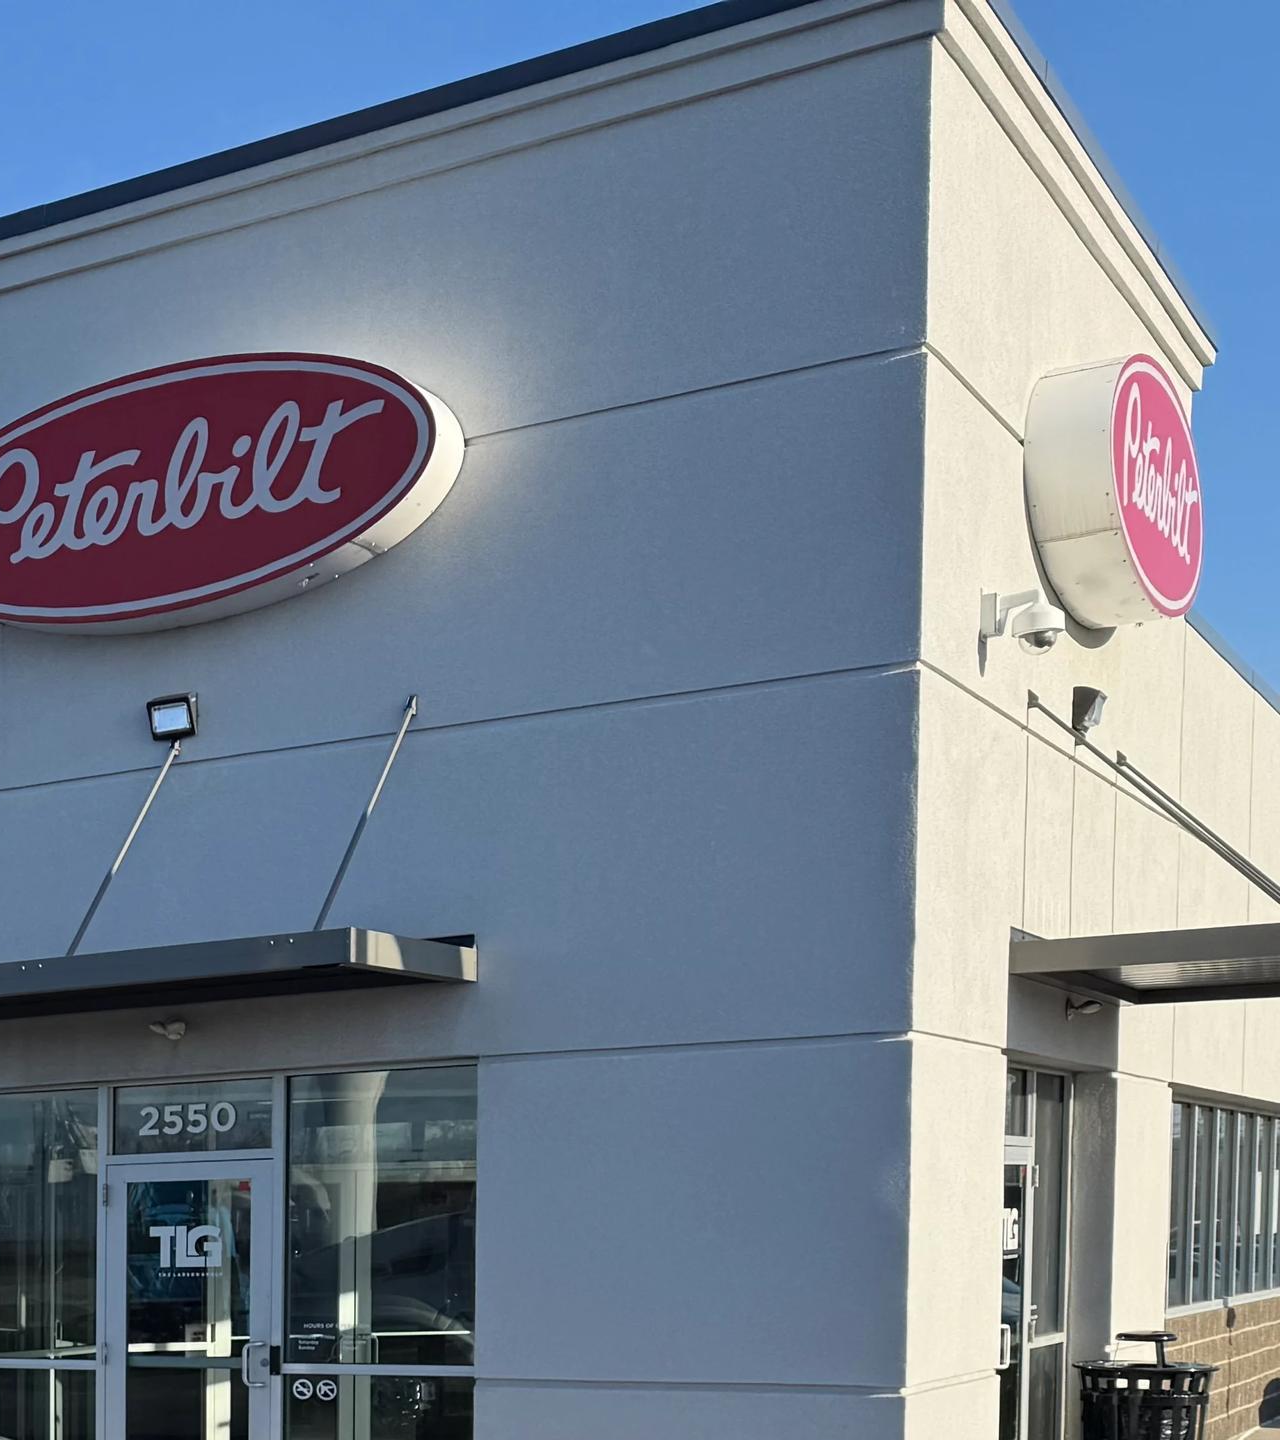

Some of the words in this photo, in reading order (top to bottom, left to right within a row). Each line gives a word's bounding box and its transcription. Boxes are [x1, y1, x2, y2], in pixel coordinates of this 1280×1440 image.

[1123, 382, 1198, 565] Peterbilt
[138, 1101, 237, 1137] 2550
[149, 1224, 222, 1268] TLG
